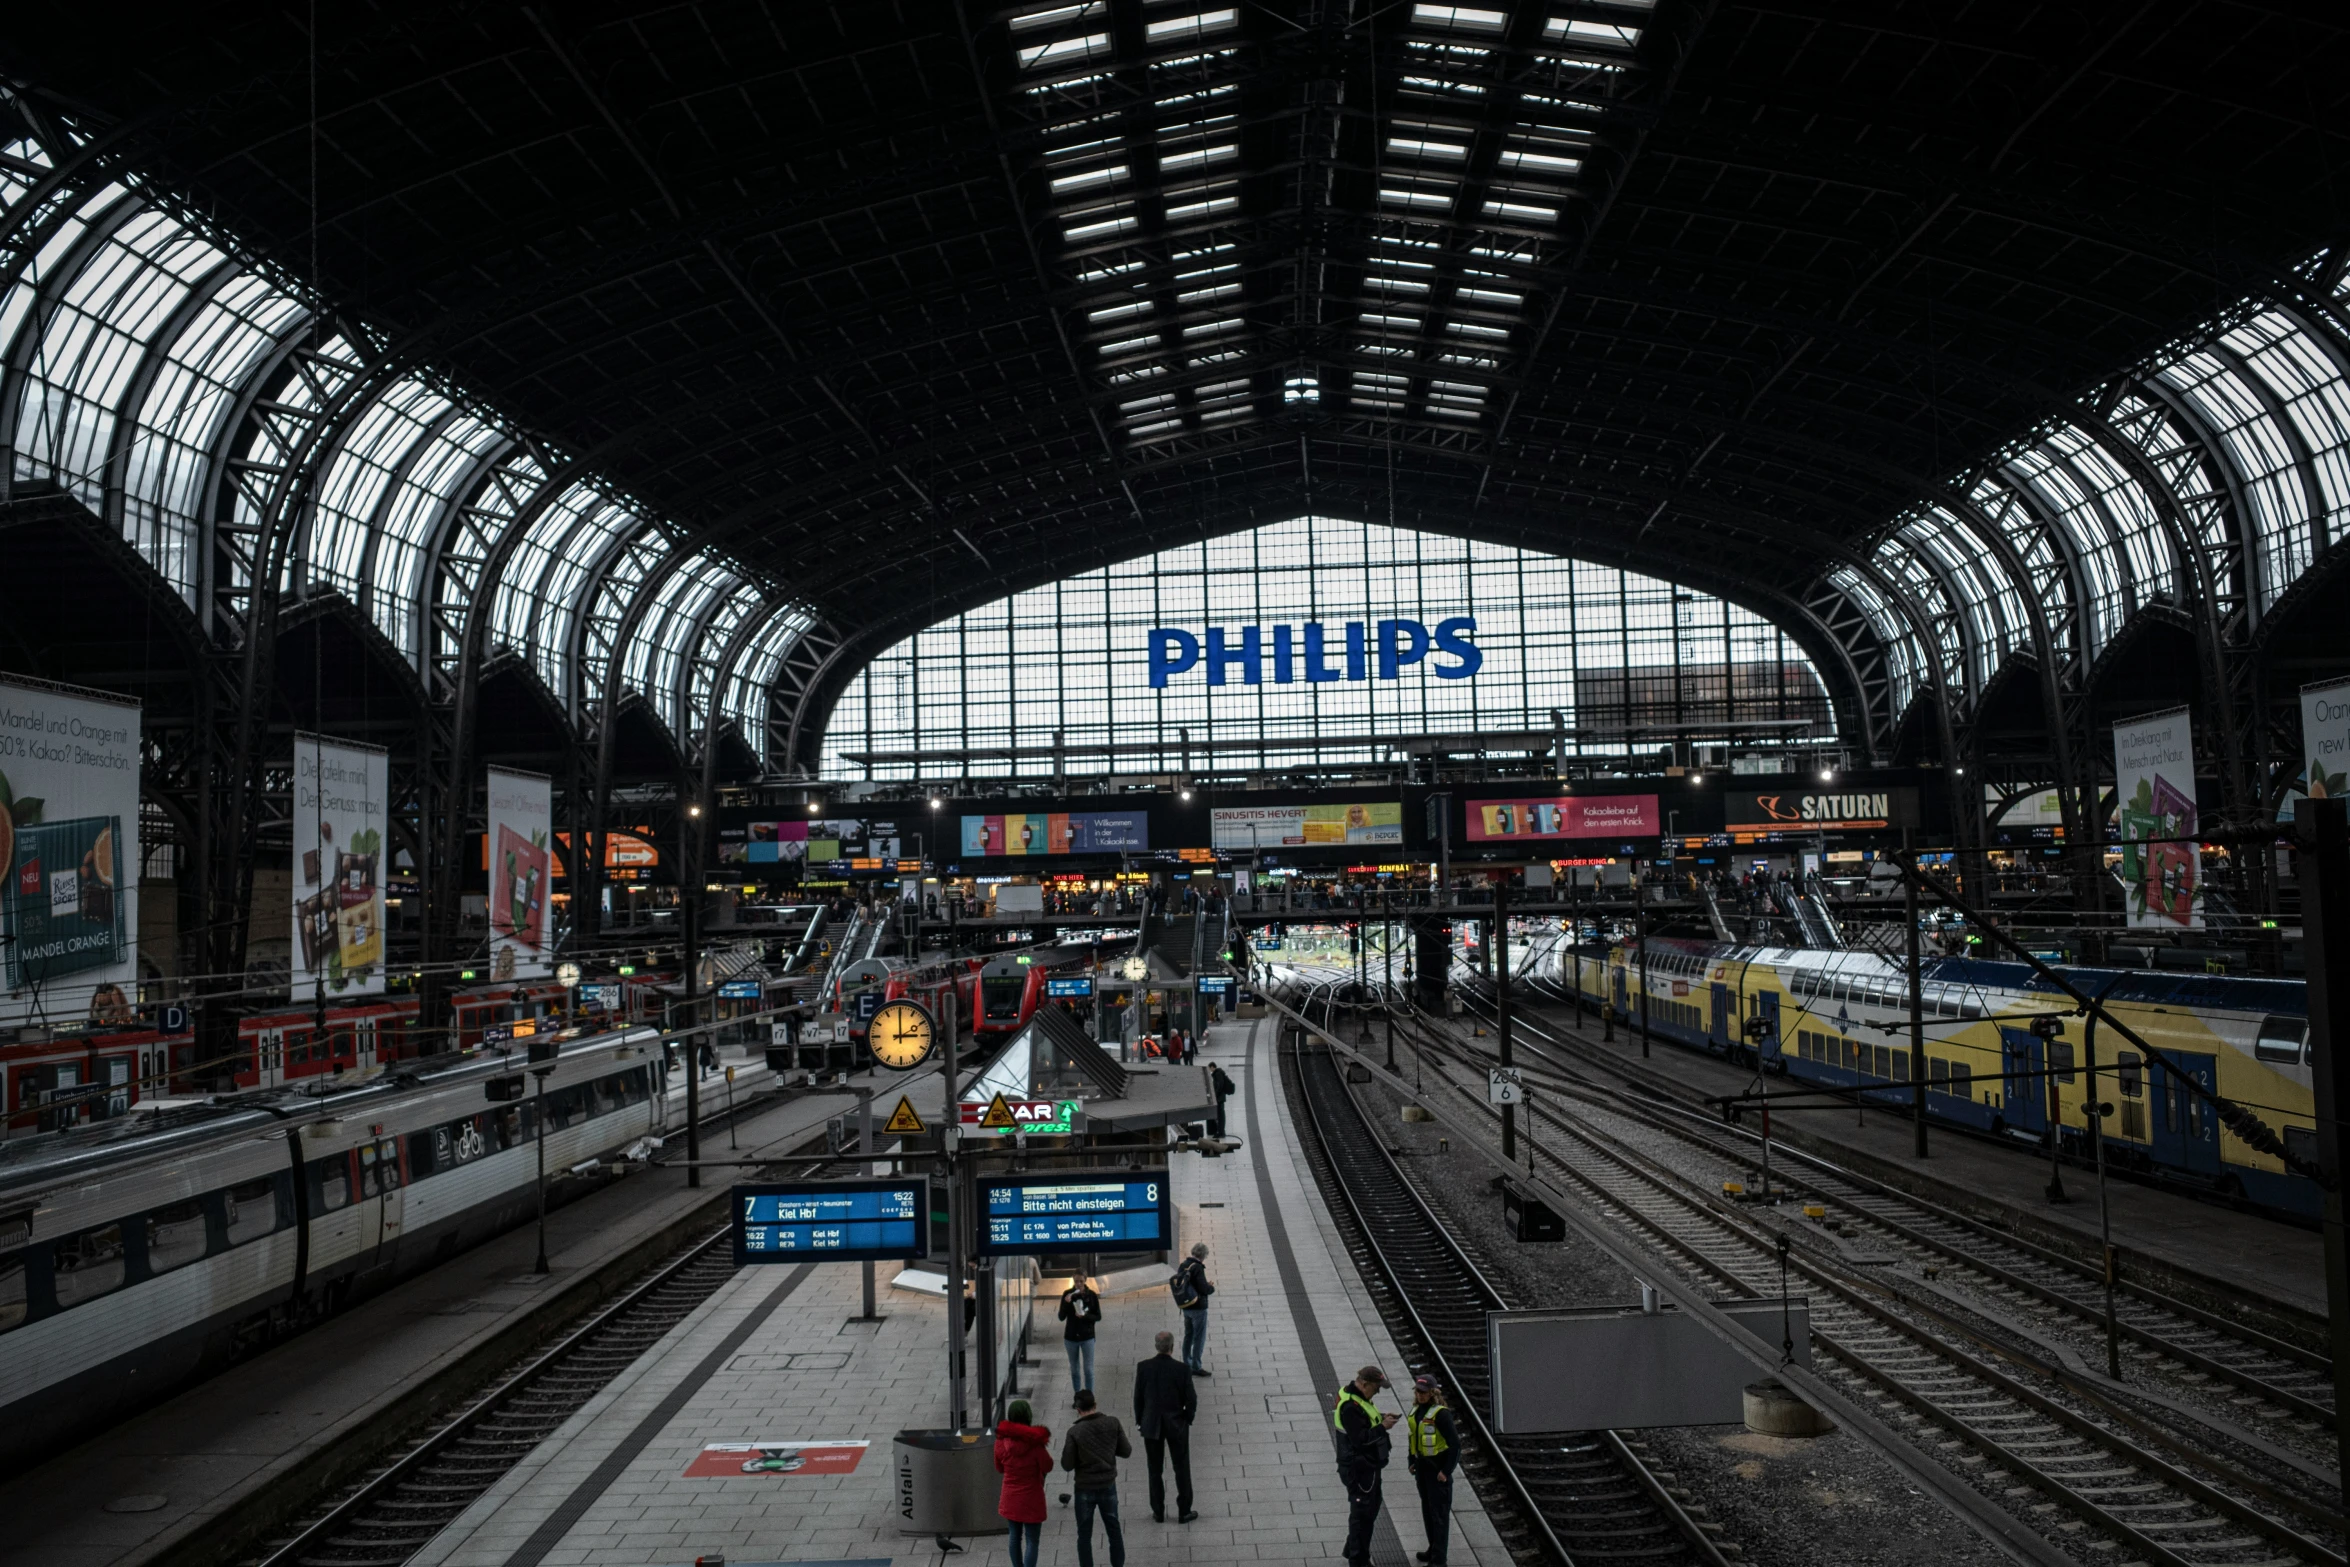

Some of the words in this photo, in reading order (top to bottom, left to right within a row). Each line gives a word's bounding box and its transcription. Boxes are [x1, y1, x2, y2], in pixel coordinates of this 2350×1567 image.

[1148, 617, 1483, 688] PHILIPS
[2315, 700, 2350, 722] Oran
[47, 715, 67, 735] und
[70, 718, 112, 747] Orange
[113, 727, 128, 744] mit
[2121, 735, 2130, 749] Im
[2130, 729, 2161, 748] Dreiklang
[2162, 726, 2172, 741] mit
[2318, 738, 2345, 755] new
[29, 739, 71, 763] Kakao?
[74, 745, 130, 770] Bitterschön.
[2123, 754, 2149, 770] Mensch
[2149, 749, 2163, 766] und
[301, 756, 317, 779] Die
[301, 786, 319, 808] Der
[1583, 805, 1625, 816] Kakaoliebe
[1627, 804, 1639, 815] auf
[1802, 793, 1888, 820] SATURN
[1214, 810, 1265, 820] SINUSITIS
[1267, 808, 1307, 819] HEVERT
[1094, 818, 1133, 828] Willkommen
[1583, 818, 1599, 828] den
[1599, 817, 1621, 827] ersten
[1622, 816, 1645, 827] Knick.
[1094, 829, 1101, 837] in
[1101, 828, 1113, 837] der
[1558, 858, 1587, 866] BURGER
[1587, 857, 1608, 866] KING
[22, 871, 39, 884] NEU
[1053, 874, 1068, 882] NUR
[1068, 873, 1085, 881] HIER
[53, 893, 77, 906] SPORT
[21, 941, 66, 962] MANDEL
[67, 931, 110, 953] ORANGE
[601, 988, 617, 997] 286
[605, 998, 612, 1006] 6
[860, 996, 874, 1017] E
[167, 1007, 183, 1029] D
[774, 1028, 785, 1039] r7
[807, 1027, 819, 1037] v7
[837, 1026, 847, 1037] t7
[2201, 1070, 2208, 1086] 2
[1501, 1086, 1511, 1099] 6
[2007, 1085, 2013, 1099] 2
[977, 1104, 1052, 1121] SAR
[2204, 1127, 2211, 1142] 2
[990, 1188, 1012, 1198] 14:54
[1147, 1183, 1158, 1202] 8
[744, 1197, 756, 1216] 7
[893, 1191, 914, 1202] 15:22
[1023, 1201, 1046, 1212] Bitte
[1048, 1200, 1072, 1211] nicht
[1075, 1198, 1125, 1211] einsteigen
[778, 1208, 797, 1220] Kiel
[799, 1207, 817, 1219] Hbf
[779, 1231, 795, 1239] RE70
[812, 1230, 826, 1238] Kiel
[827, 1229, 840, 1238] Hbf
[990, 1224, 1009, 1232] 15:11
[1023, 1223, 1032, 1231] EC
[1057, 1223, 1070, 1231] von
[1071, 1222, 1091, 1230] Praha
[990, 1233, 1009, 1241] 15:25
[1071, 1230, 1101, 1239] München
[1101, 1229, 1114, 1238] Hbf
[745, 1241, 765, 1250] 17:22
[779, 1241, 795, 1249] RE70
[812, 1239, 826, 1248] Kiel
[827, 1239, 840, 1247] Hbf
[901, 1468, 914, 1520] Abfall
